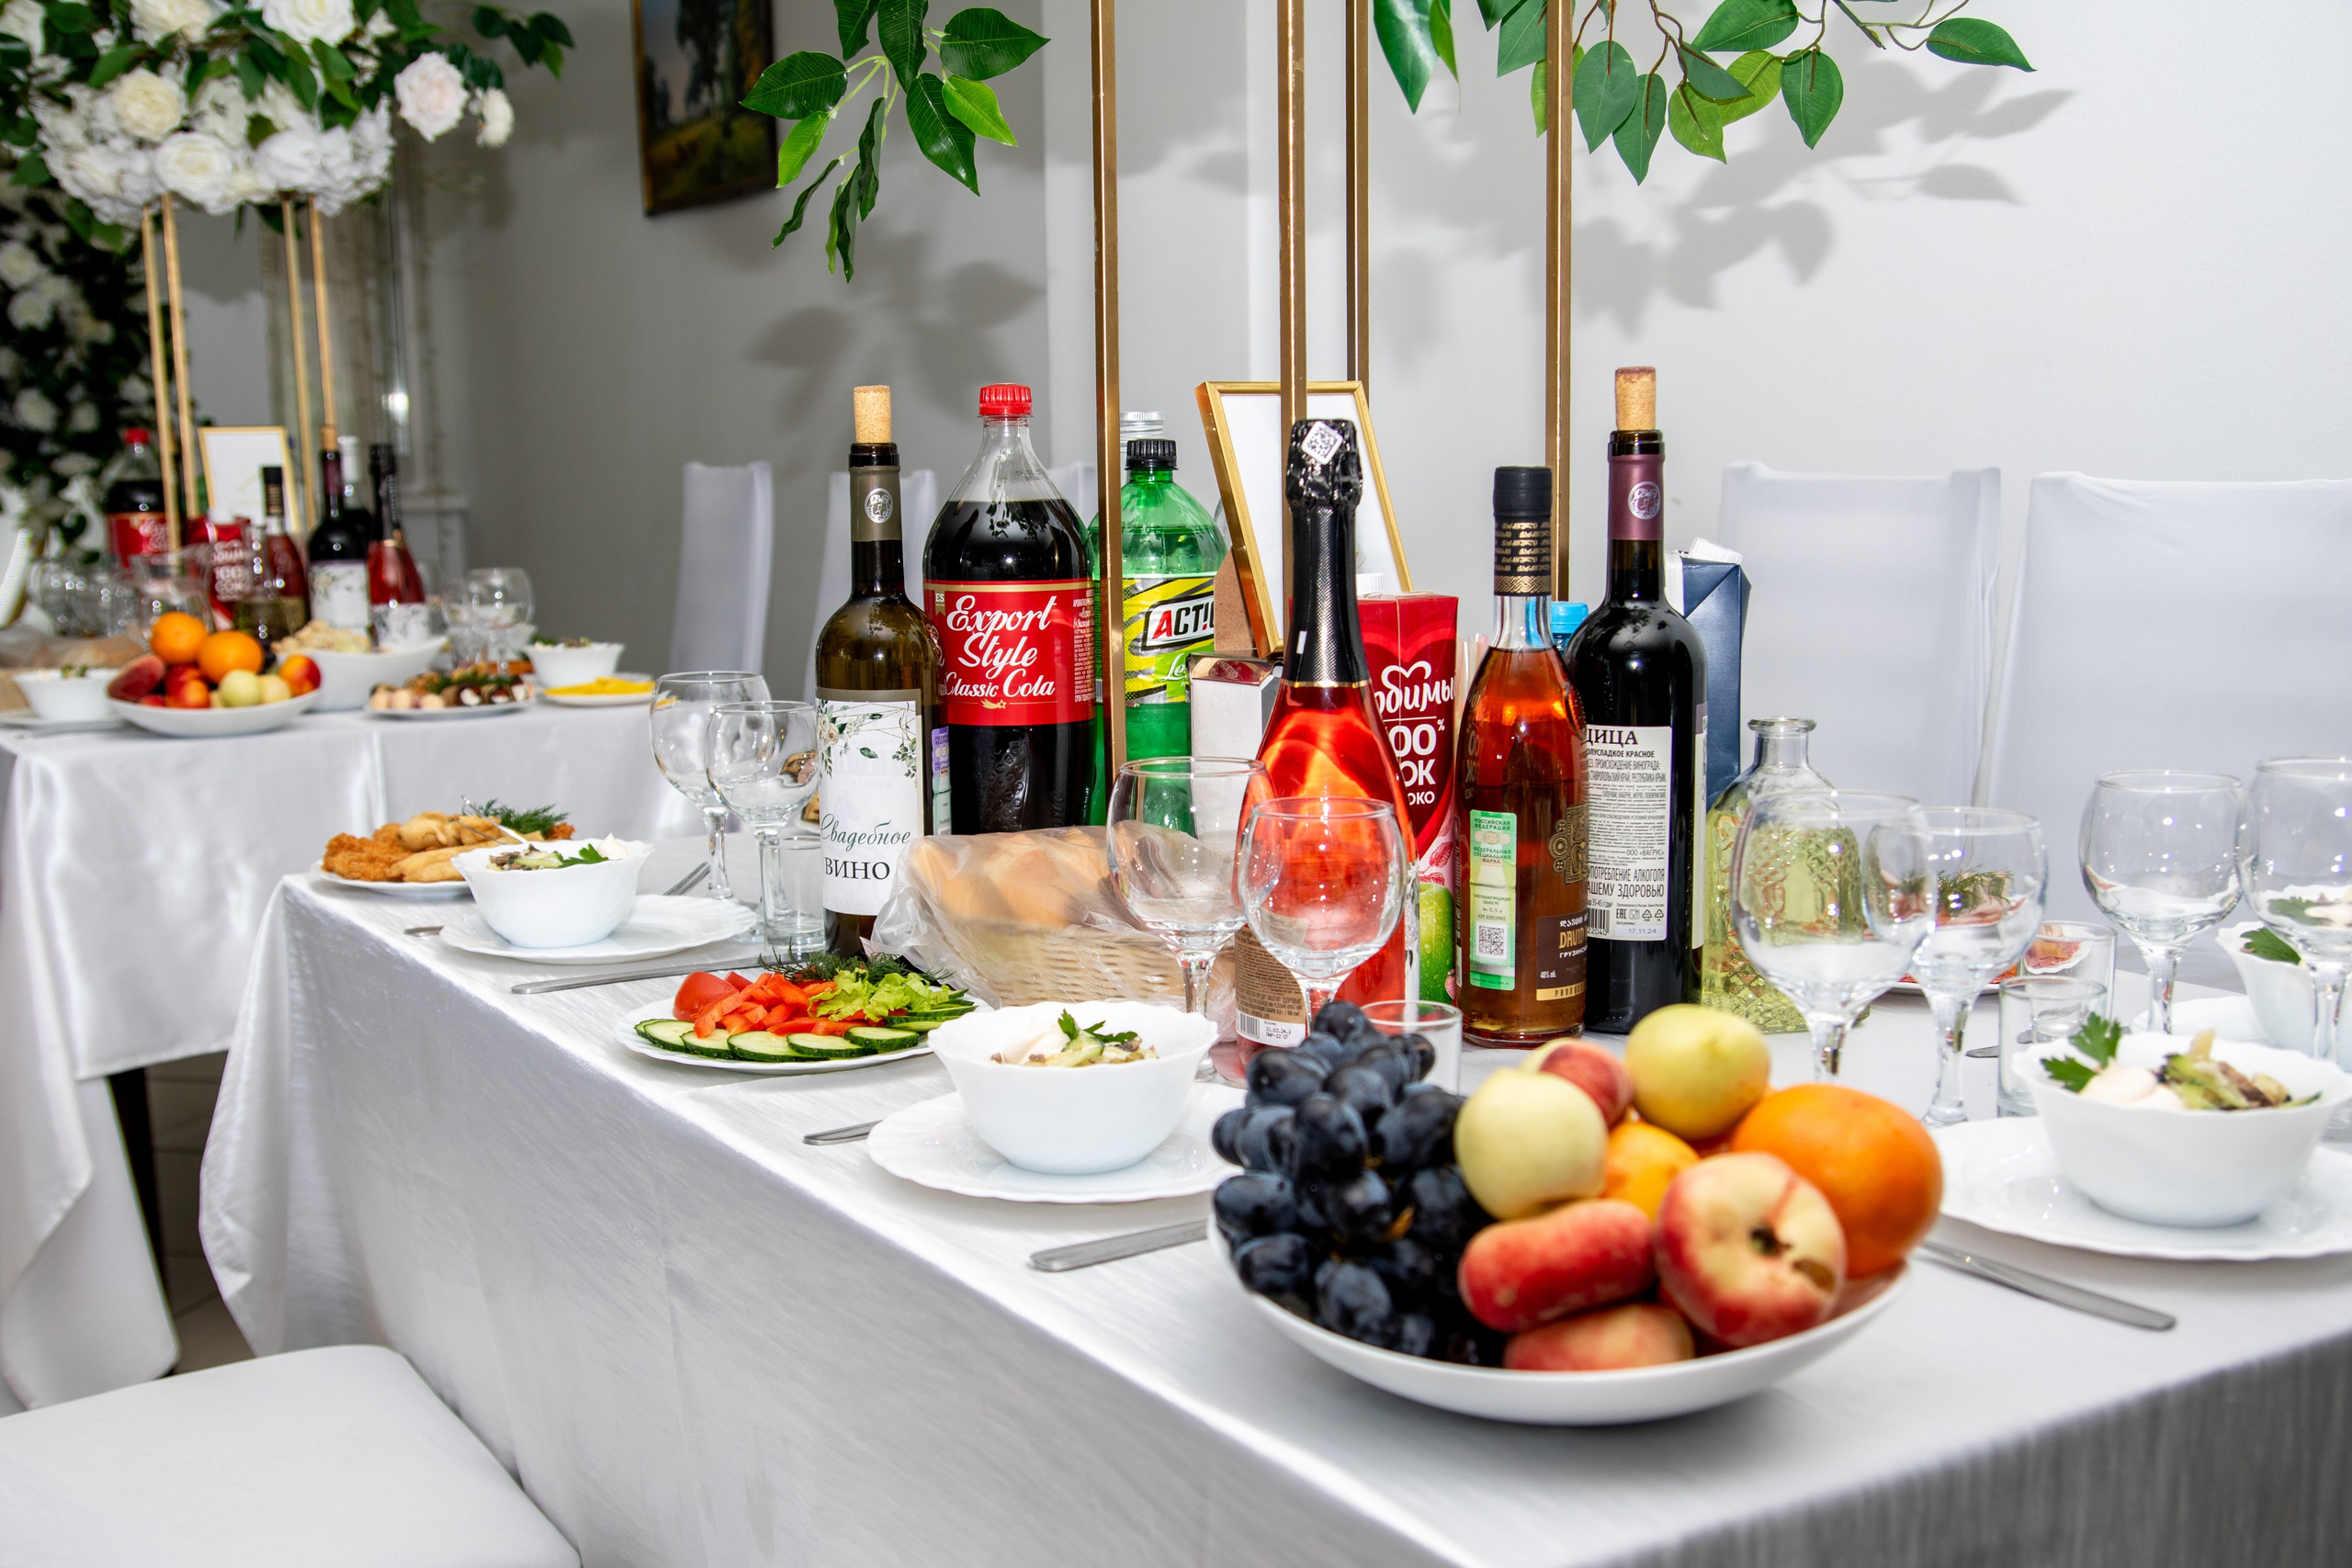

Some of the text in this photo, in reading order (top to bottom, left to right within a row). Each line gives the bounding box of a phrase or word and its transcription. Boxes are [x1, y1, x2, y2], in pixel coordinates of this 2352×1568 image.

[946, 594, 1057, 650] Export
[957, 631, 1038, 680] Style
[945, 668, 1056, 697] Classic Cola
[1587, 749, 1624, 758] ОЛУСЛАДКОЕ
[1399, 759, 1436, 787] ОК
[820, 813, 911, 852] Свадебное
[824, 856, 890, 880] ВИНО
[1634, 868, 1665, 882] АЛКОГОЛЯ
[1588, 881, 1664, 899] АШЕМУ ЗДОРОВЬЮ
[1558, 927, 1584, 949] DAVID
